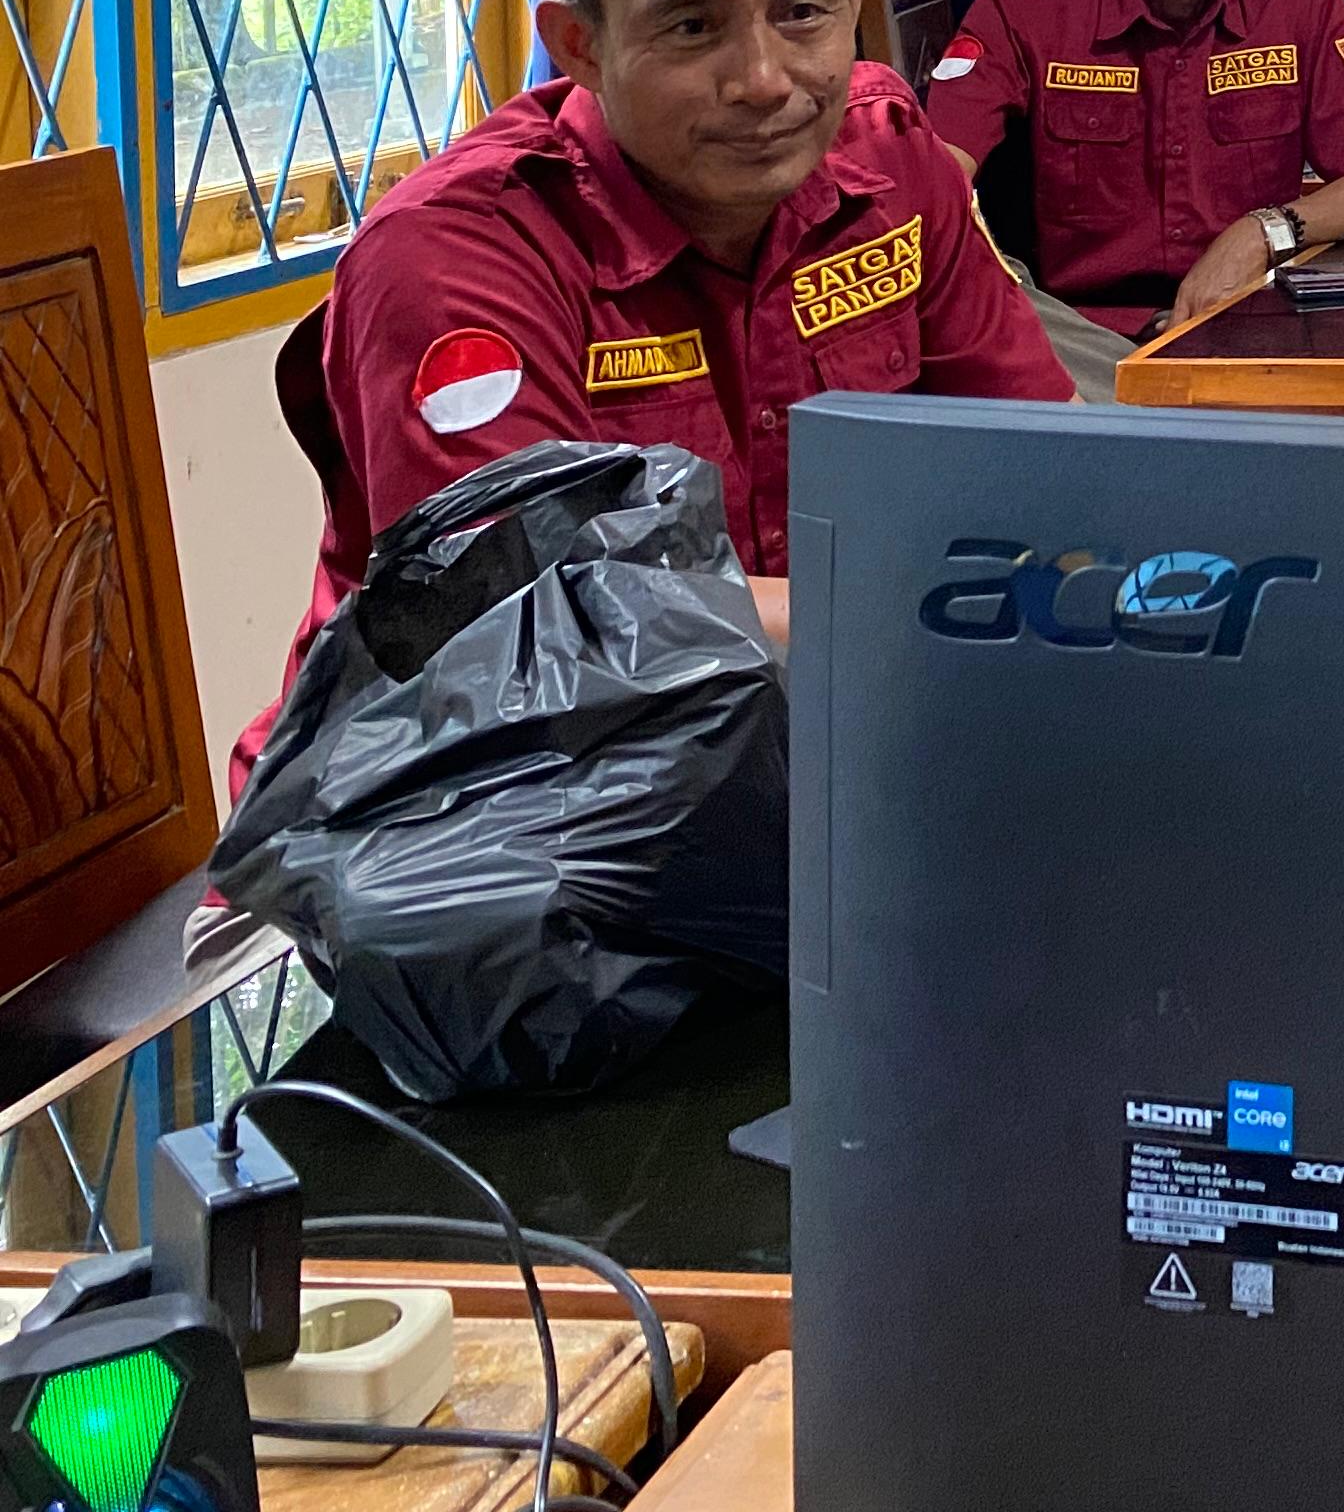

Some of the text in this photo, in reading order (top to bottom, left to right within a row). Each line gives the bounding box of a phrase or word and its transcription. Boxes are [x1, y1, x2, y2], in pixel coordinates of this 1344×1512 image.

[1211, 50, 1293, 74] SATGAS
[1056, 68, 1133, 86] RUDIANTO
[1215, 67, 1291, 88] PANGAN
[794, 227, 920, 301] SATGAS
[919, 538, 1322, 662] acer
